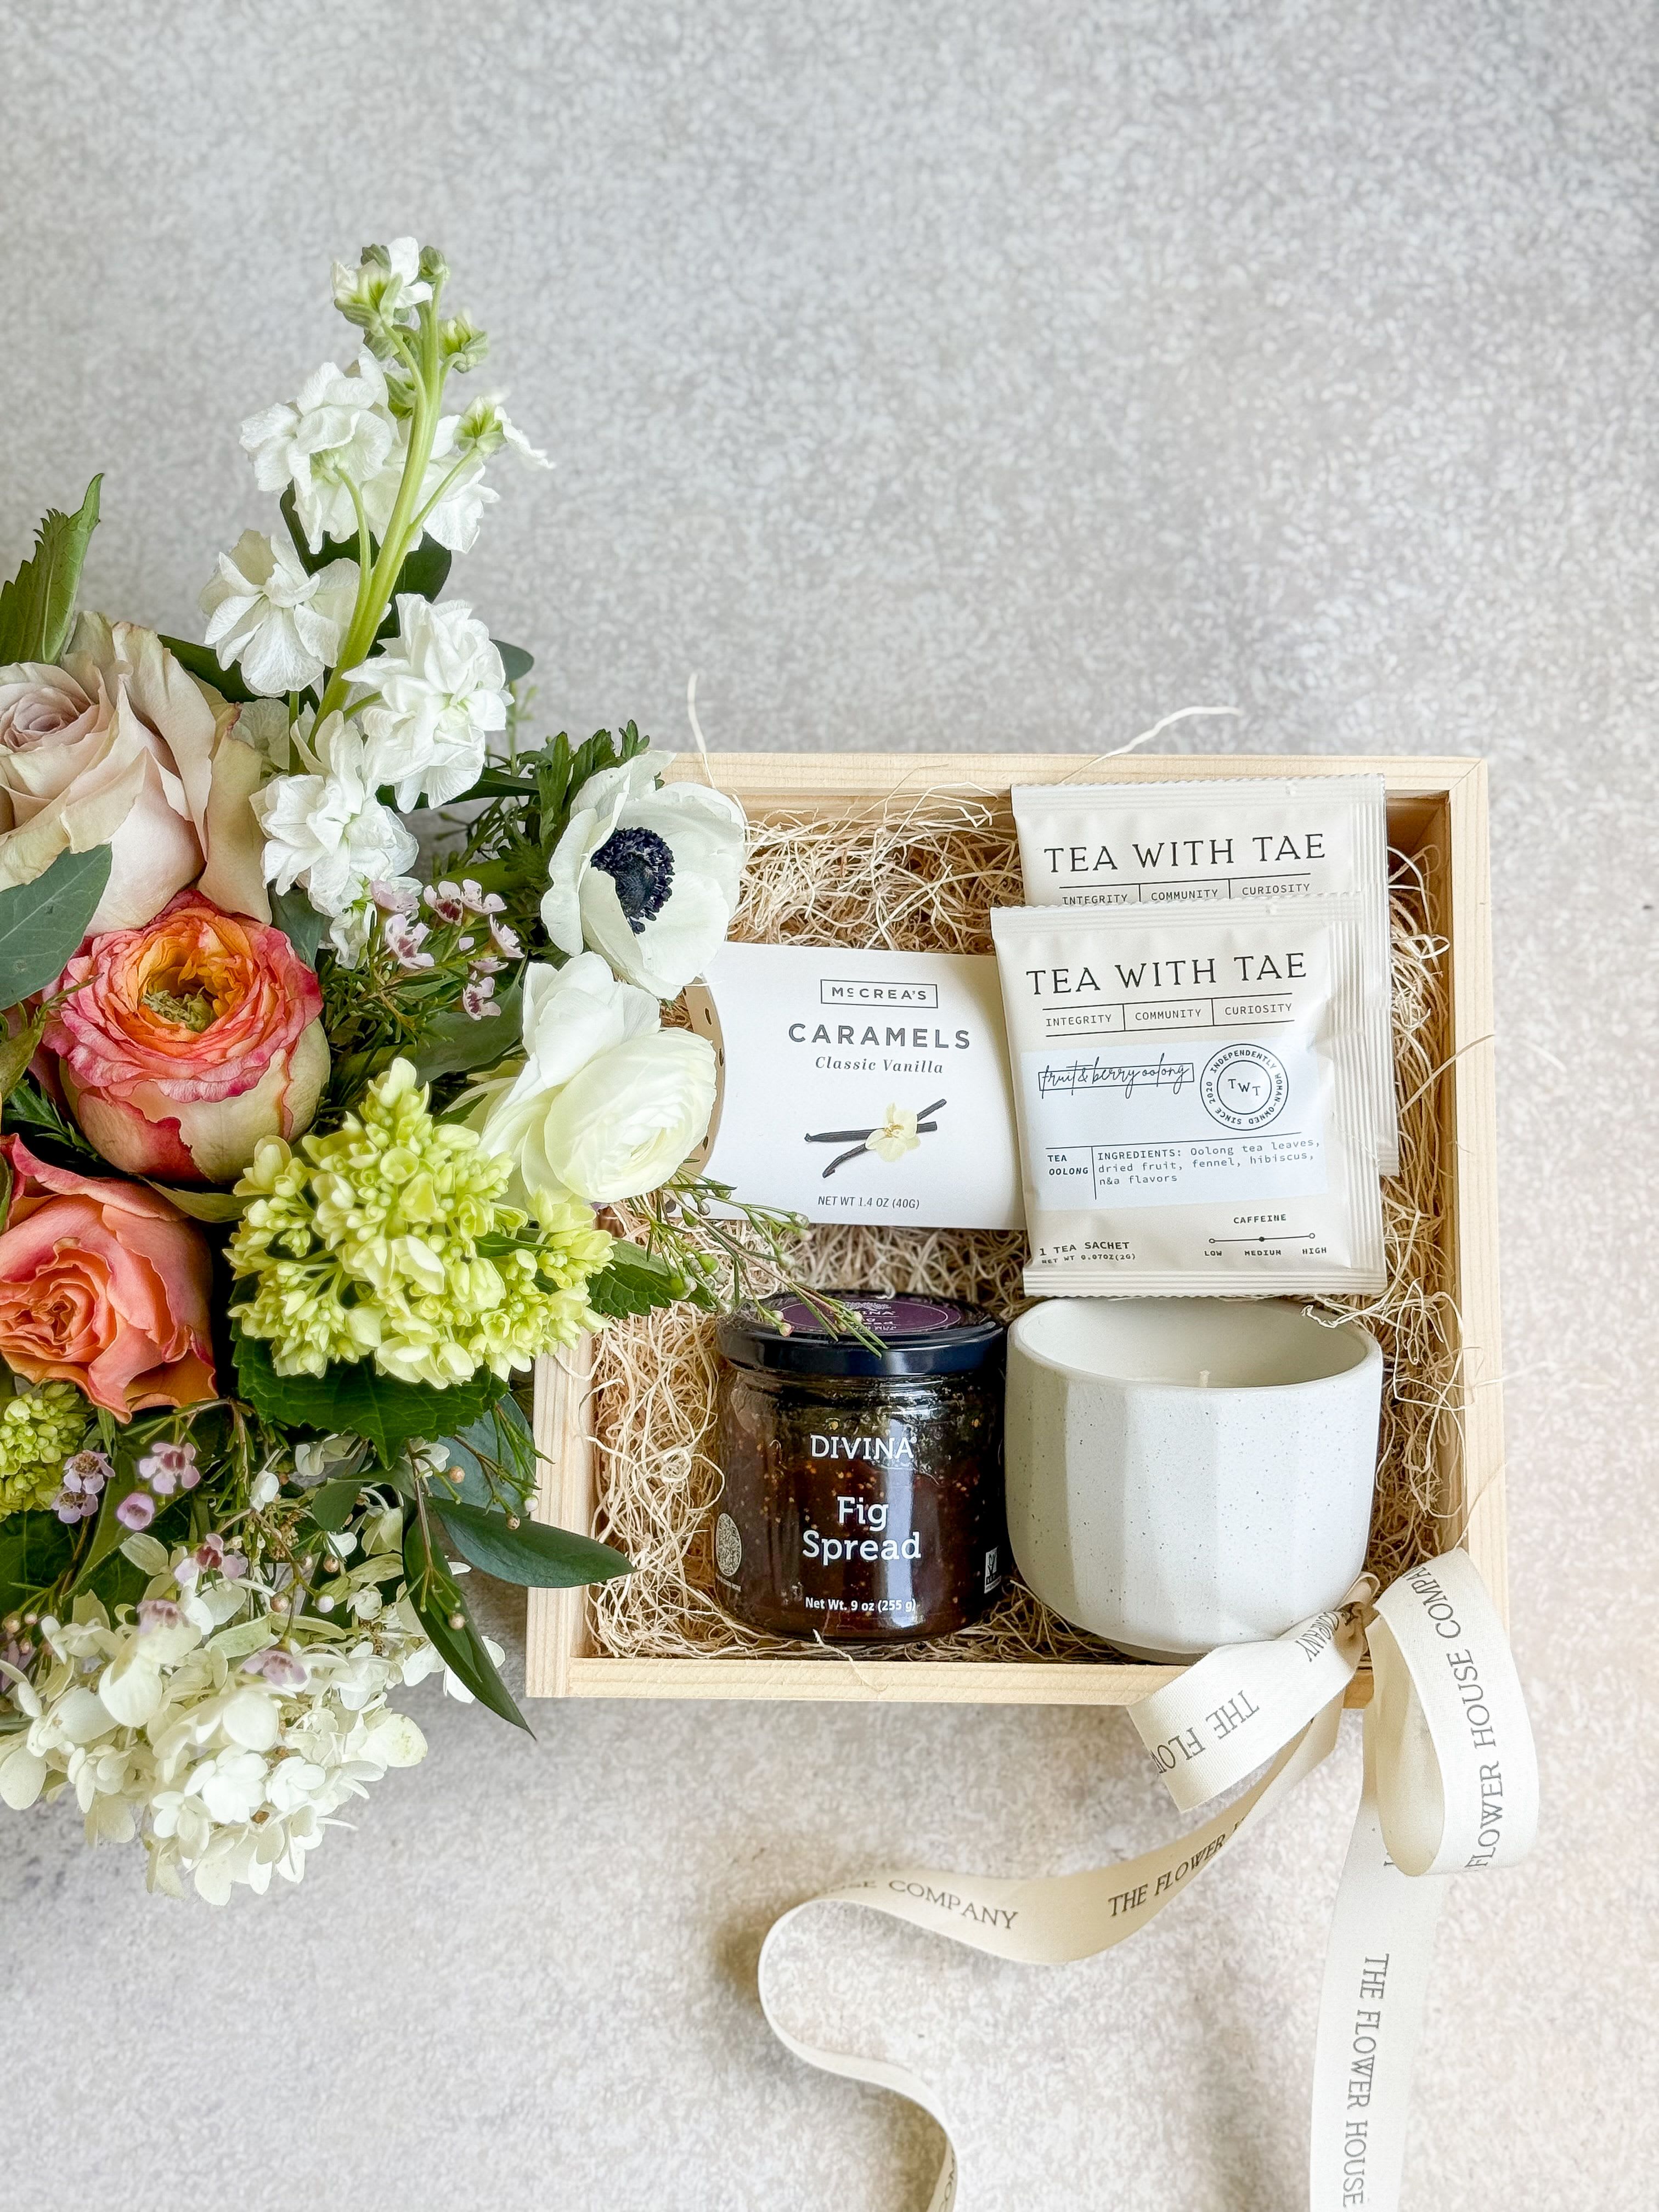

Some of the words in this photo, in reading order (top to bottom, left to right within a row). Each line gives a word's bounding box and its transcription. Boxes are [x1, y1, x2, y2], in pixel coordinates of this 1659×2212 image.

[1044, 846, 1118, 873] TEA
[1132, 838, 1234, 868] WITH
[1252, 833, 1325, 862] TAE
[1062, 894, 1128, 905] INTEGRITY
[1150, 889, 1218, 901] COMMUNITY
[1242, 883, 1311, 896] CURIOSITY
[1026, 967, 1101, 995] TEA
[1115, 958, 1217, 989] WITH
[1233, 952, 1307, 981] TAE
[1045, 1013, 1112, 1027] INTEGRITY
[1135, 1008, 1201, 1022] COMMUNITY
[1224, 1003, 1292, 1016] CURIOSITY
[788, 1023, 970, 1049] CARAMELS
[815, 1056, 876, 1070] Classic
[883, 1059, 943, 1074] Vanilla
[1210, 1049, 1277, 1074] INDEPENDENTLY
[1092, 1057, 1141, 1099] berry
[1142, 1053, 1190, 1095] oolong
[1206, 1081, 1216, 1104] 2020
[1215, 1107, 1242, 1125] SINCE
[1047, 1154, 1067, 1163] TEA
[1098, 1149, 1181, 1161] INGREDIENTS:
[1190, 1147, 1234, 1156] Oolong
[1242, 1144, 1263, 1153] tea
[1271, 1139, 1320, 1150] leaves,
[1048, 1167, 1089, 1176] OOLONG
[1098, 1163, 1133, 1173] dried
[1143, 1161, 1183, 1171] fruit,
[1193, 1157, 1241, 1168] fennel,
[1250, 1153, 1314, 1165] hibiscus,
[1099, 1177, 1120, 1186] n&a
[1130, 1174, 1177, 1184] flavors
[817, 1195, 838, 1206] NET
[840, 1197, 856, 1206] WT
[858, 1197, 873, 1207] 1.4
[876, 1198, 890, 1207] OZ
[892, 1198, 919, 1210] (40G)
[1233, 1214, 1286, 1224] CAFFEINE
[1039, 1248, 1047, 1256] 1
[1053, 1244, 1077, 1254] TEA
[1084, 1242, 1130, 1250] SACHET
[1302, 1247, 1327, 1255] HIGH
[837, 1496, 889, 1532] Fig
[803, 1530, 921, 1566] Spread
[805, 1596, 826, 1610] Net
[828, 1599, 847, 1611] Wt.
[851, 1600, 858, 1611] 9
[861, 1602, 874, 1611] oz
[878, 1599, 902, 1613] (255
[905, 1598, 916, 1613] g)
[1446, 1649, 1497, 1750] HOUSE
[1205, 1690, 1260, 1740] THE
[1464, 1760, 1503, 1868] FLOWER
[1107, 1883, 1148, 1917] THE
[1154, 1833, 1226, 1897] FLOWER
[888, 1880, 1019, 1929] COMPANY
[1359, 1953, 1390, 2000] THE
[1346, 2010, 1381, 2110] FLOWER
[1342, 2120, 1368, 2209] HOUSE
